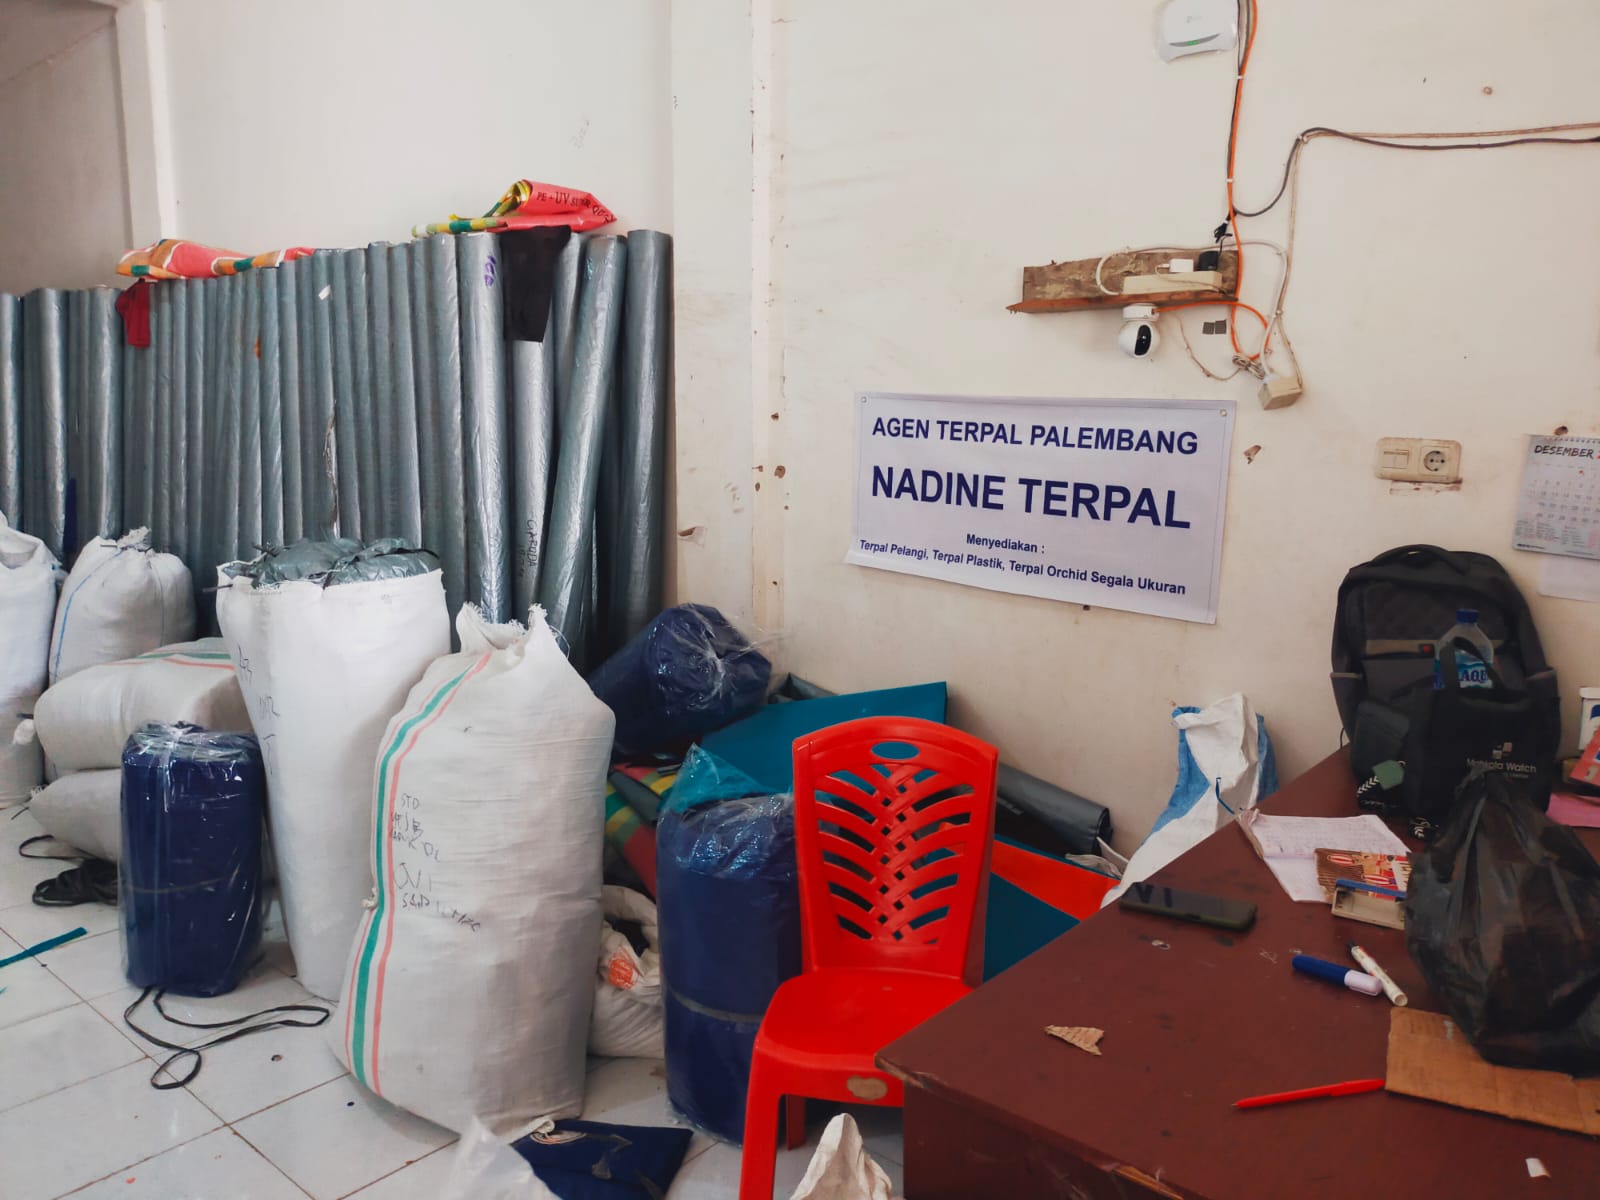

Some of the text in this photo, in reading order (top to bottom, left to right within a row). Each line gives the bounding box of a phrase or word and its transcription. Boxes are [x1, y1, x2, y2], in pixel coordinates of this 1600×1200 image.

[555, 191, 570, 204] UV
[872, 417, 1198, 455] AGEN TERPAL PALEMBANG
[1534, 444, 1594, 459] DESEMBER
[872, 465, 1191, 529] NADINE TERPAL
[966, 533, 1038, 554] Menyediakan
[860, 539, 1186, 595] Terpal Pelangi, Terpal Plastik, Terpal Orchid Segala Ukuran
[1506, 761, 1537, 774] Watch
